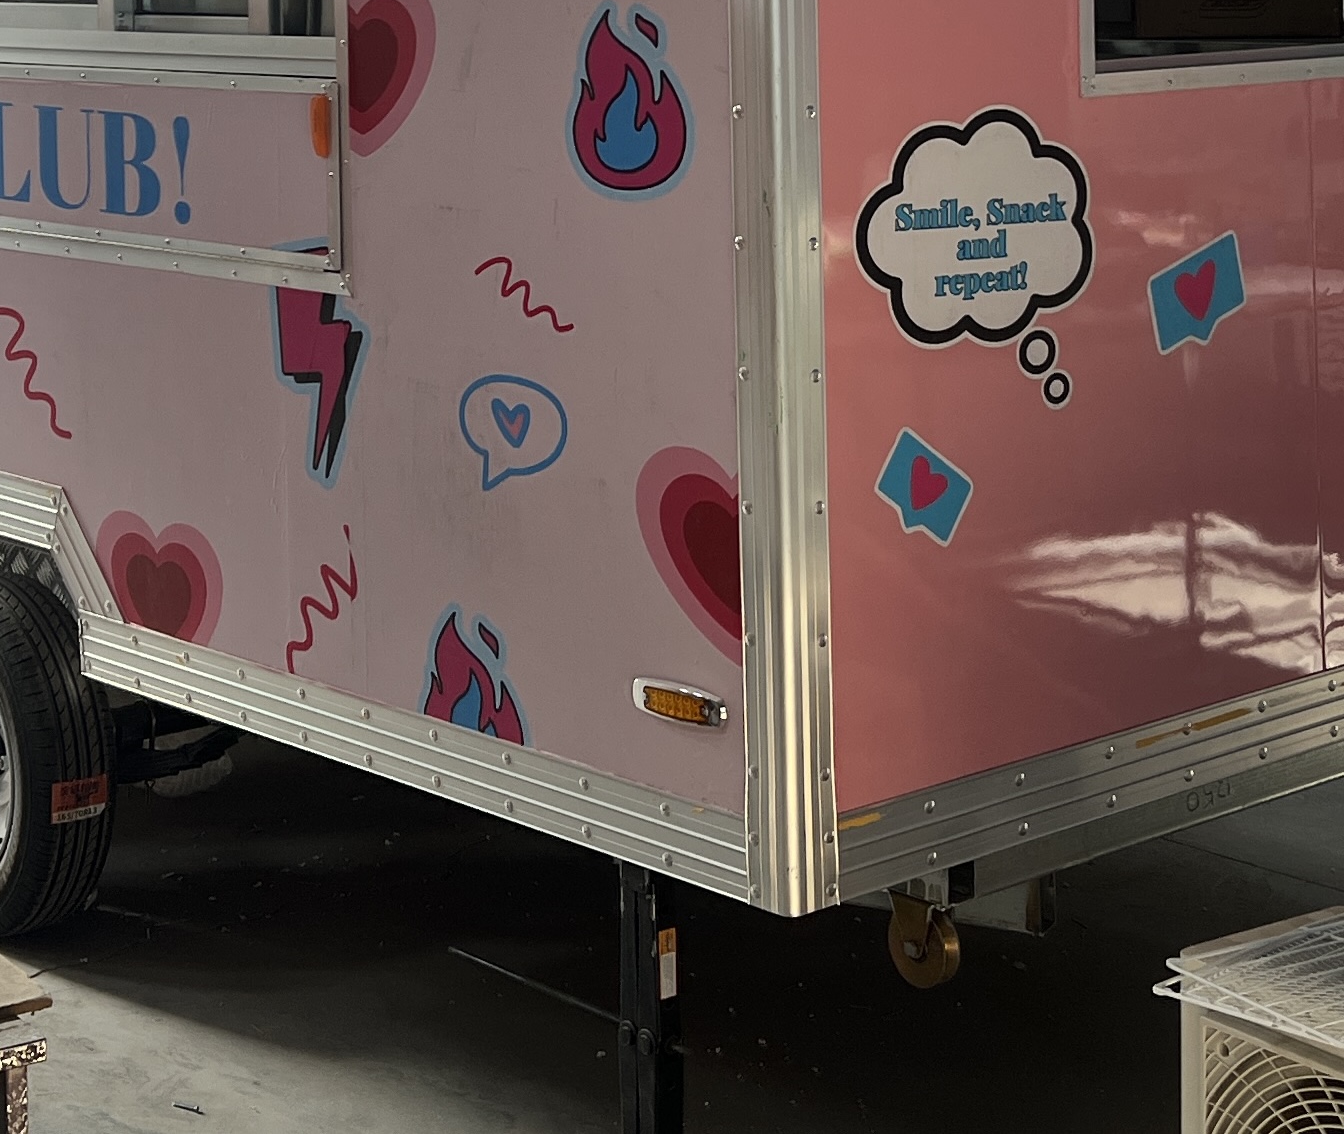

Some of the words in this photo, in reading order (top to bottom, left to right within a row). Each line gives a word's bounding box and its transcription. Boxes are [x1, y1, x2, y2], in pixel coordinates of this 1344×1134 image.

[895, 198, 981, 232] Smile,
[986, 193, 1067, 226] Snack
[956, 229, 1008, 261] and
[934, 261, 1028, 301] repeat!
